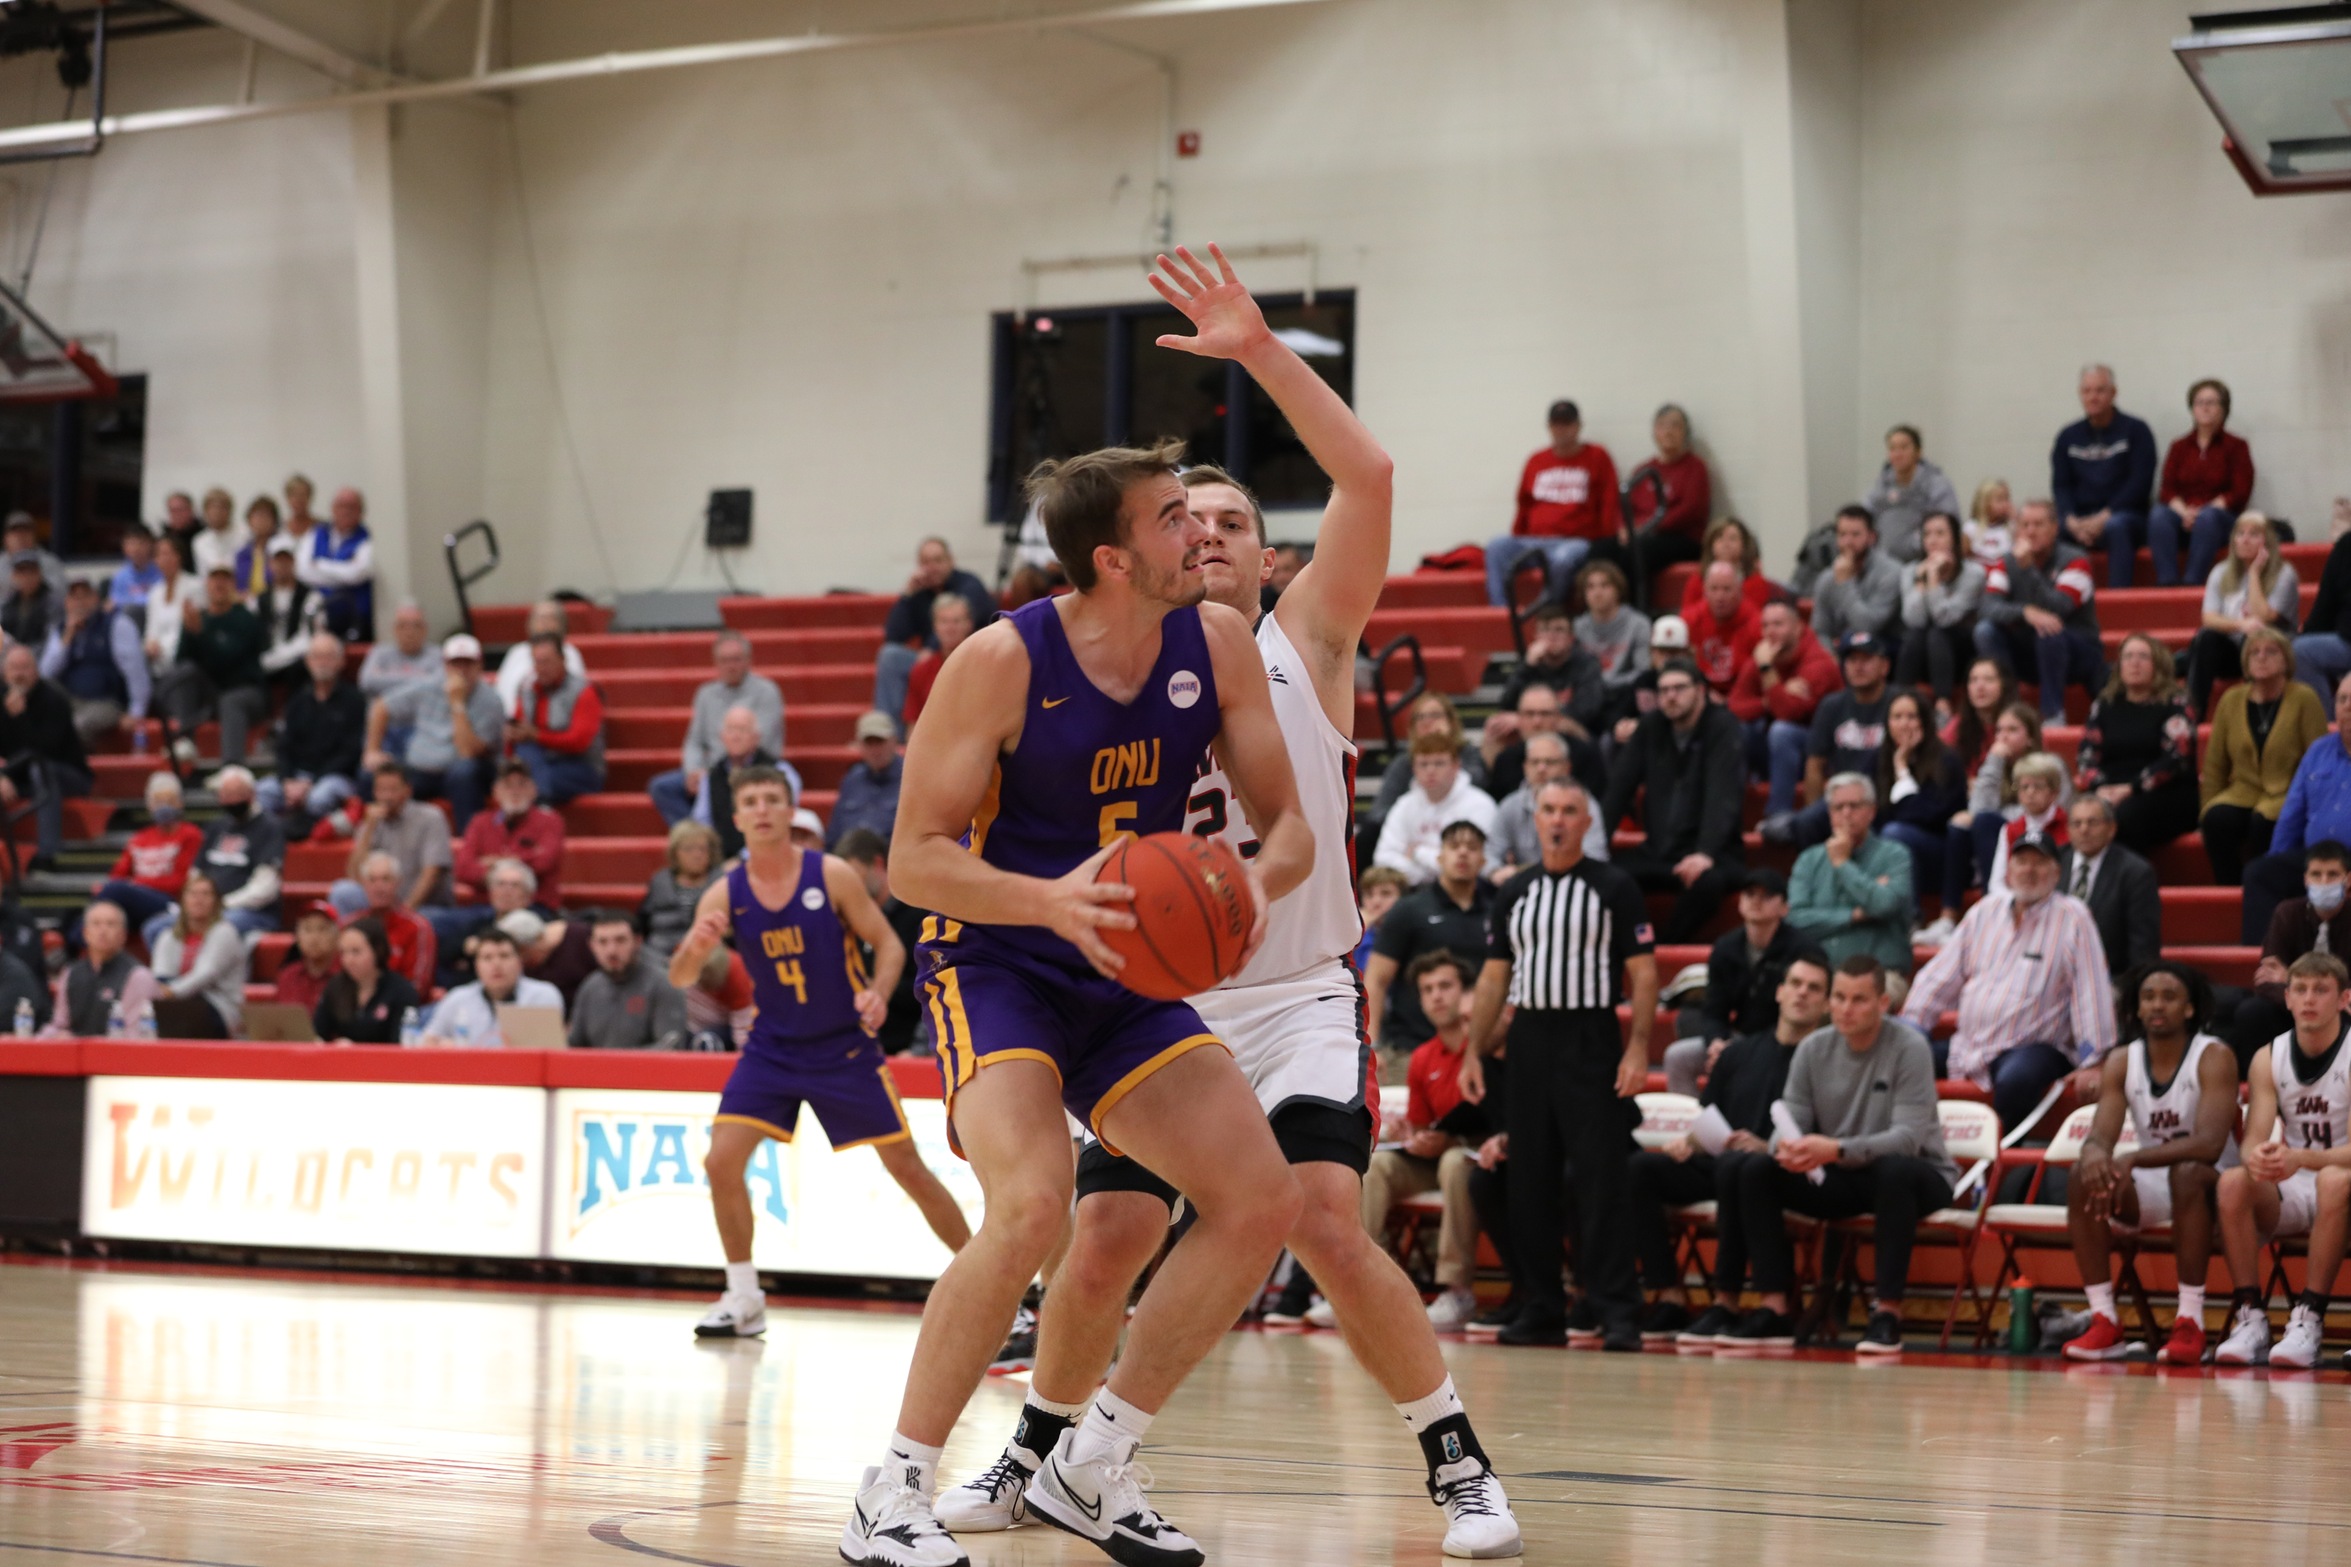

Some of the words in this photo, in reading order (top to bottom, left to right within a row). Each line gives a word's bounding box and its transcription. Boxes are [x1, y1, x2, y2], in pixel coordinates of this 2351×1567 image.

[1090, 738, 1160, 795] ONU
[761, 924, 804, 958] ONU
[775, 959, 808, 1004] 4
[579, 1121, 788, 1227] NAA
